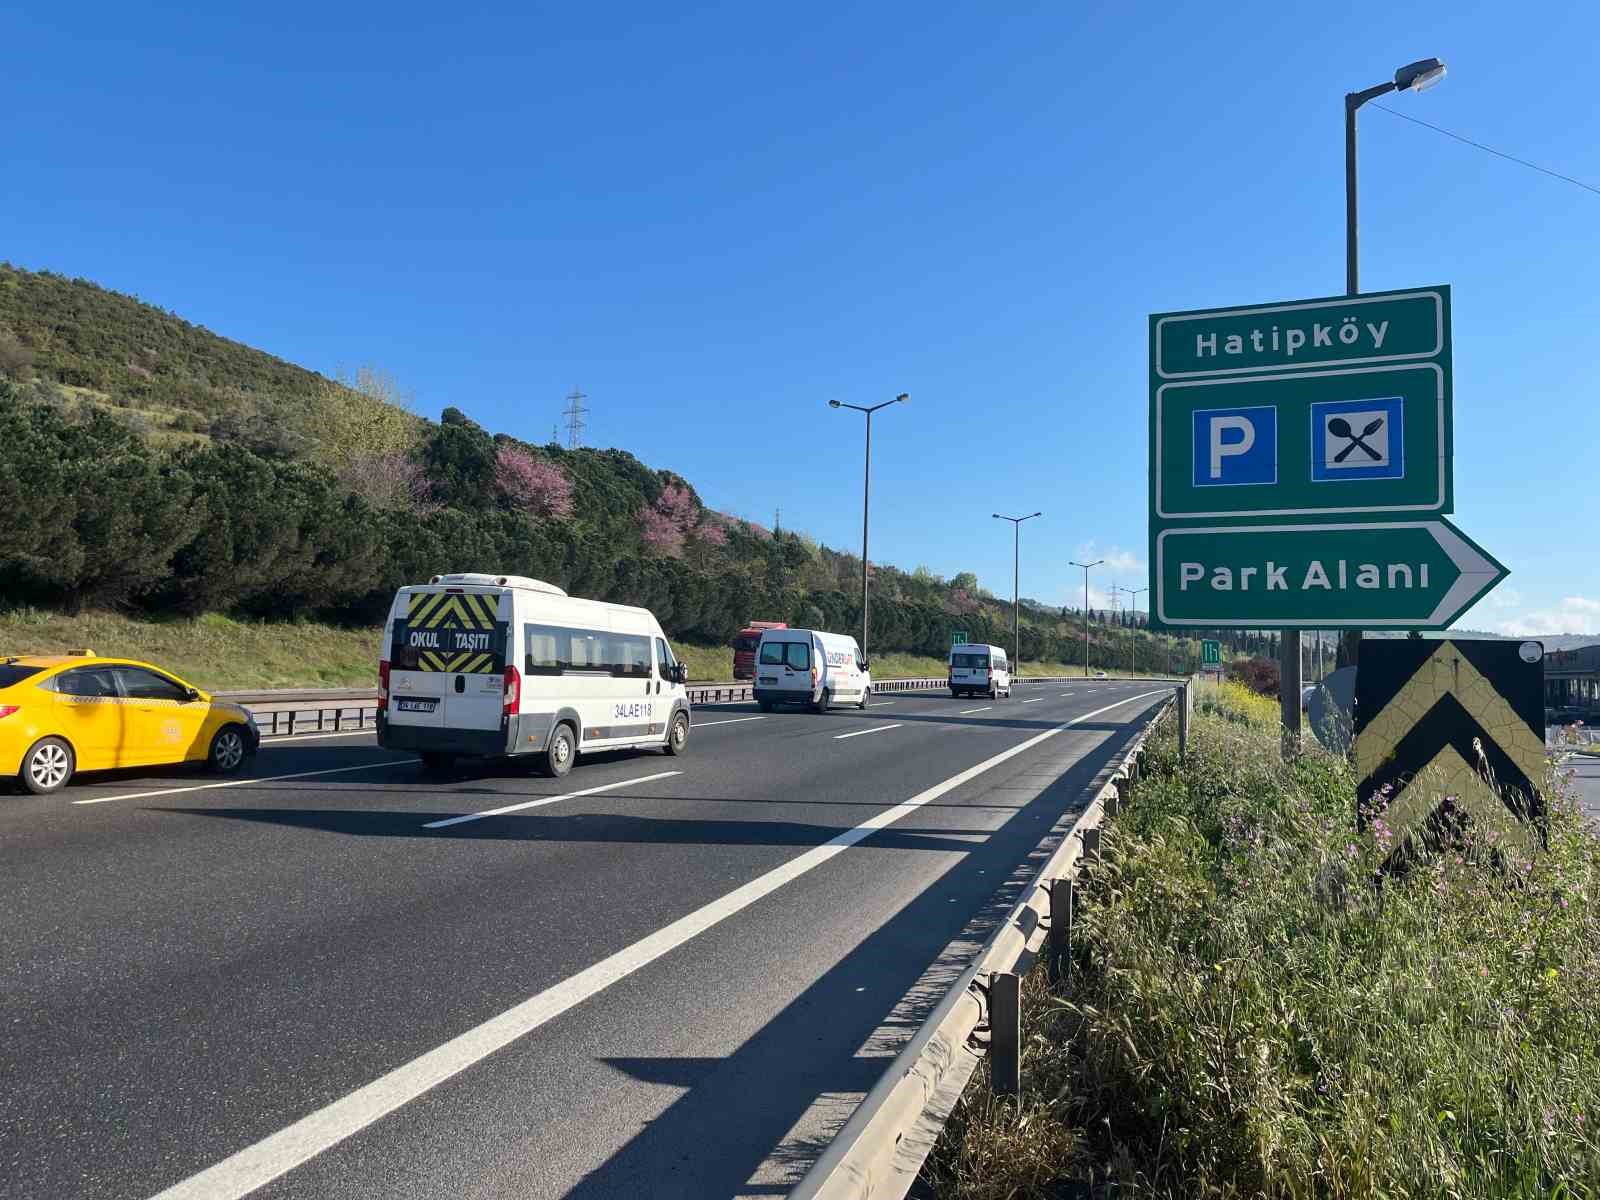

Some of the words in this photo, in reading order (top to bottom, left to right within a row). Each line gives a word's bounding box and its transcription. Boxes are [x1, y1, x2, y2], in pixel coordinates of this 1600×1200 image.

[1195, 316, 1389, 357] Hatipköy
[1209, 415, 1256, 479] P
[1179, 560, 1289, 591] Park
[1301, 558, 1430, 591] Alanı
[410, 631, 440, 648] OKUL
[614, 703, 652, 718] 34LAE118
